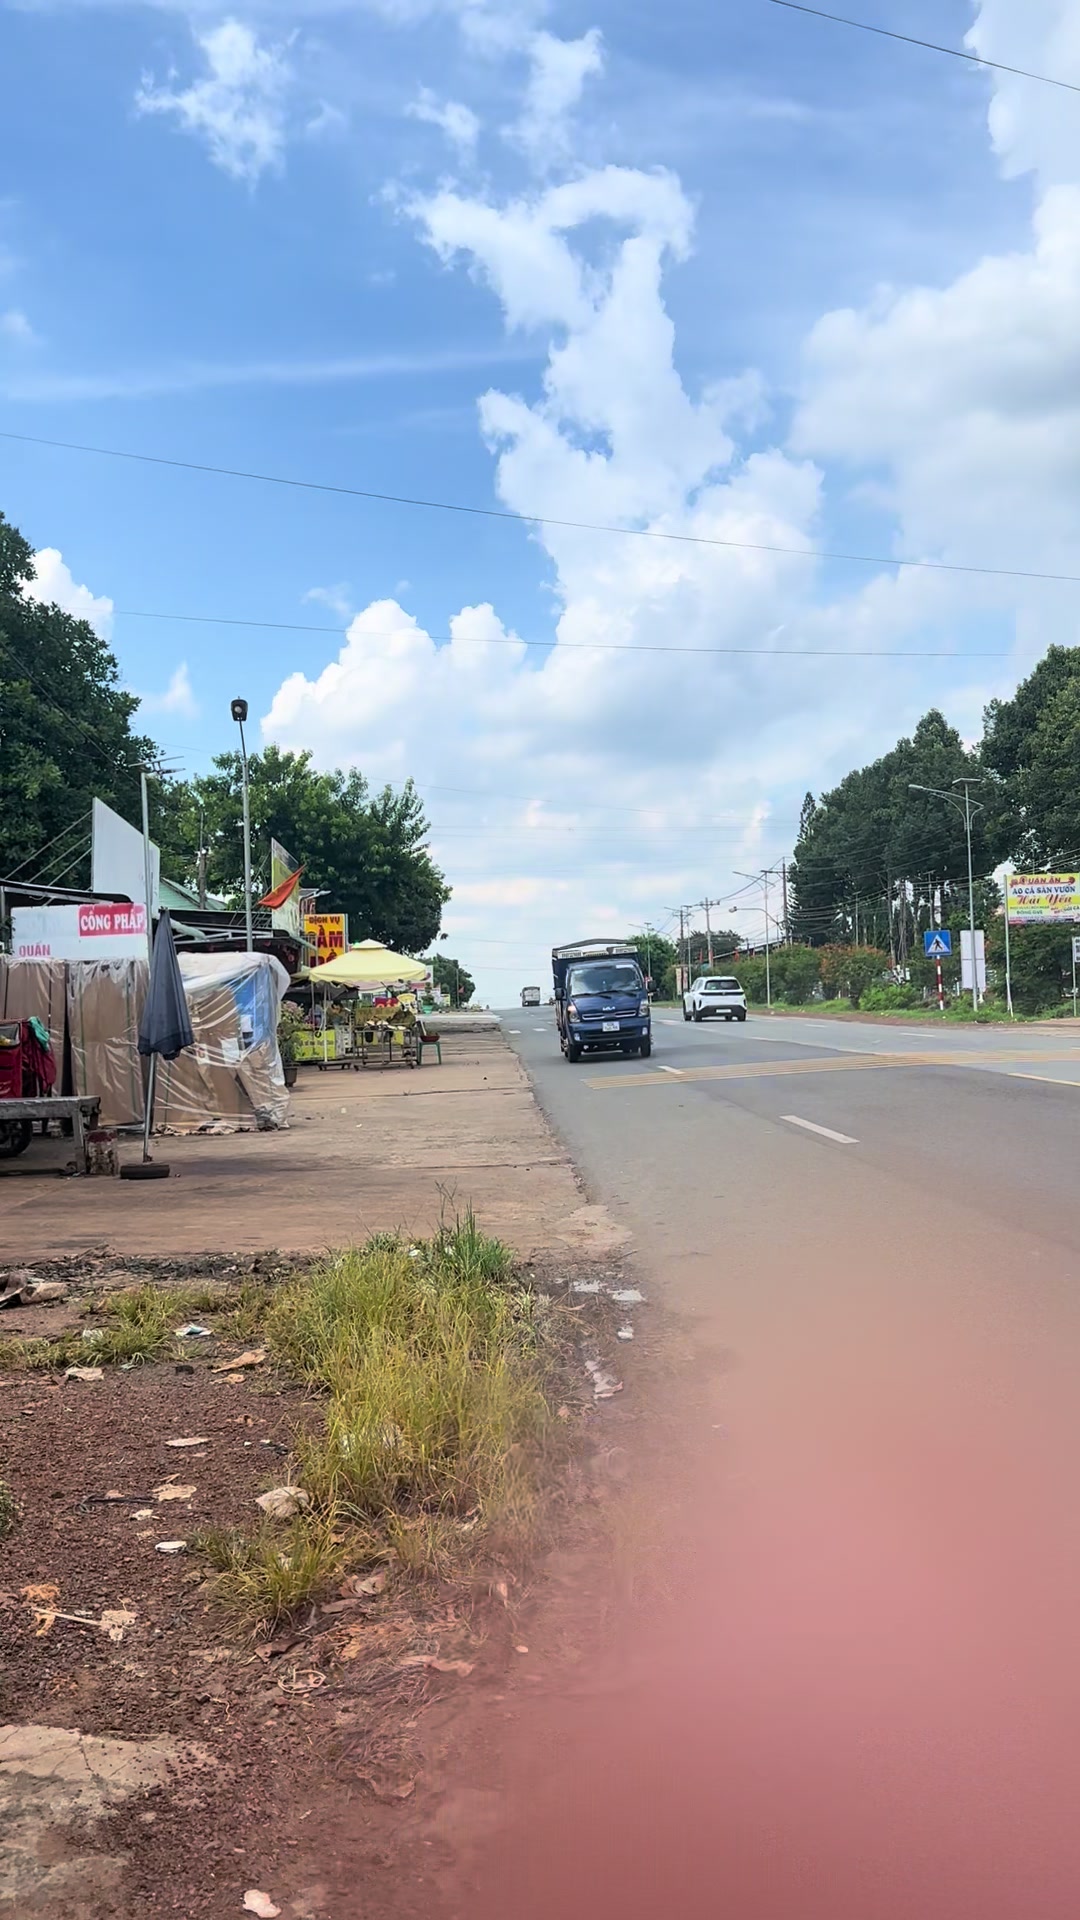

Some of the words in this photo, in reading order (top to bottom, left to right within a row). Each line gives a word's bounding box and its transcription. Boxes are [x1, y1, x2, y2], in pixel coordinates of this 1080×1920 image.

[80, 910, 112, 932] CÔNG
[113, 908, 144, 930] PHÁP
[329, 916, 341, 925] VỤ
